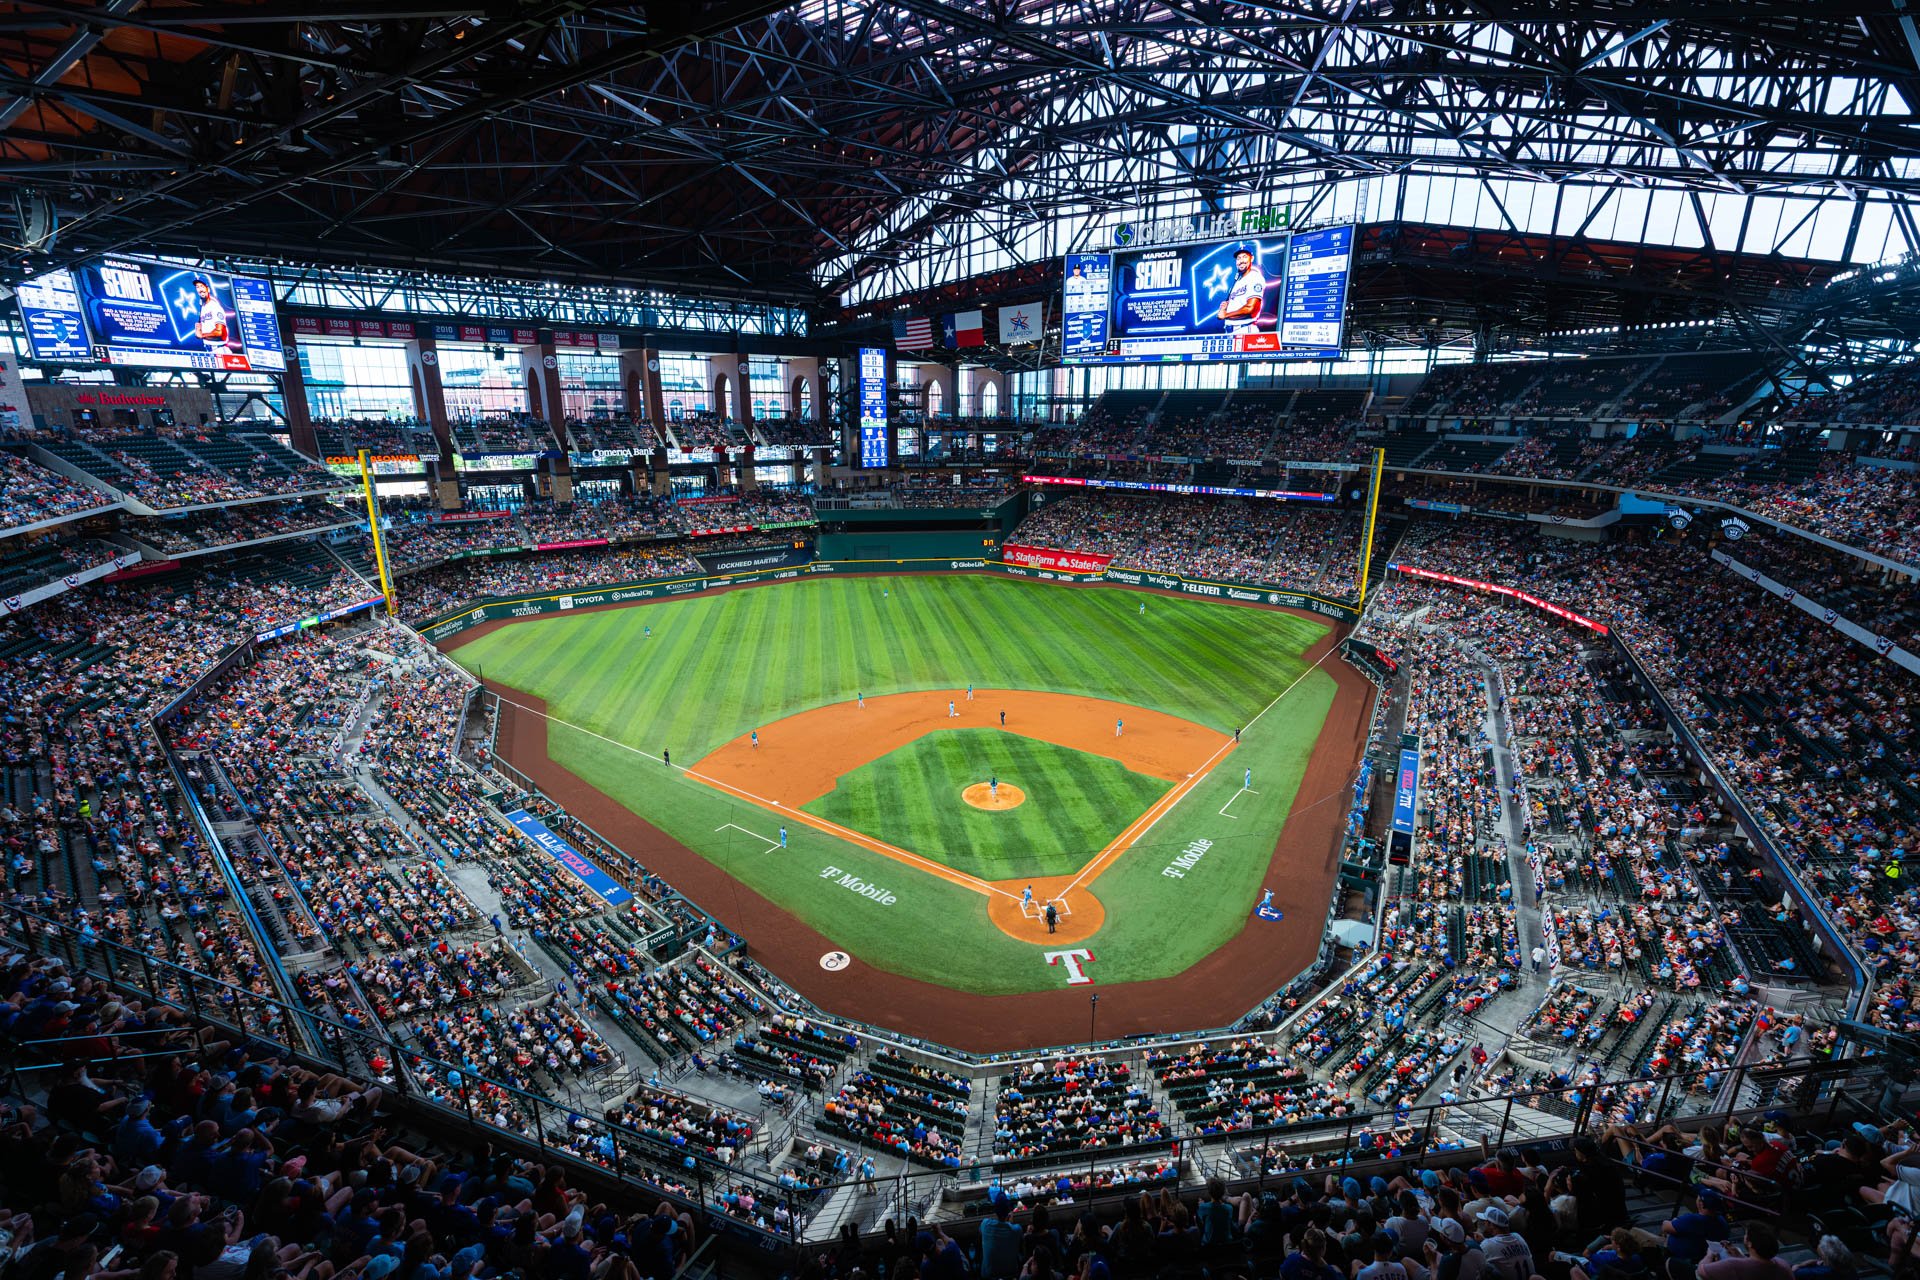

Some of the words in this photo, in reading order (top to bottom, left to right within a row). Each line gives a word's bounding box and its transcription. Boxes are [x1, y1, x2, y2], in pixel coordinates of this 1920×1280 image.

[1139, 222, 1195, 242] Globe
[1200, 212, 1237, 236] Life
[1241, 205, 1290, 231] Field
[1143, 251, 1177, 259] MARCUS
[104, 260, 141, 271] MARCUS
[1135, 258, 1183, 291] SEMIEN
[100, 267, 154, 302] SEMIEN
[295, 318, 317, 327] 1996
[329, 320, 350, 328] 1998
[361, 322, 380, 330] 1999
[392, 323, 411, 331] 2010
[436, 325, 453, 333] 2010
[465, 327, 481, 335] 2011
[554, 332, 570, 340] 2015
[579, 333, 594, 341] 2016
[1007, 330, 1033, 339] ARLINGTON
[423, 353, 436, 363] 34
[545, 358, 556, 366] 26
[99, 393, 166, 405] Budweiser
[633, 447, 655, 456] Bank
[692, 446, 714, 454] Coca-Cola
[725, 446, 746, 454] Coca-Cola
[326, 456, 355, 465] CORE
[358, 454, 420, 464] RSONNEL
[1227, 459, 1263, 467] POWERADE
[787, 520, 816, 528] STAFFING
[1721, 519, 1732, 528] JACK
[717, 559, 752, 570] LOCKHEED
[754, 557, 778, 566] MARTIN
[1016, 552, 1035, 562] State
[1036, 555, 1054, 566] Farm
[1070, 558, 1091, 570] State
[1115, 571, 1141, 581] National
[1156, 575, 1178, 589] Kroger
[643, 589, 654, 597] City
[1181, 583, 1221, 595] 7-ELEVEN
[574, 595, 604, 605] TOYOTA
[472, 609, 485, 619] UTA
[512, 605, 542, 613] ESTRELLA
[1319, 603, 1344, 618] Mobile
[535, 832, 557, 849] ALL
[559, 850, 595, 877] TEXAS
[1171, 838, 1214, 871] Mobile
[833, 873, 897, 906] Mobile
[649, 930, 675, 945] TOYOTA
[1043, 948, 1096, 986] T
